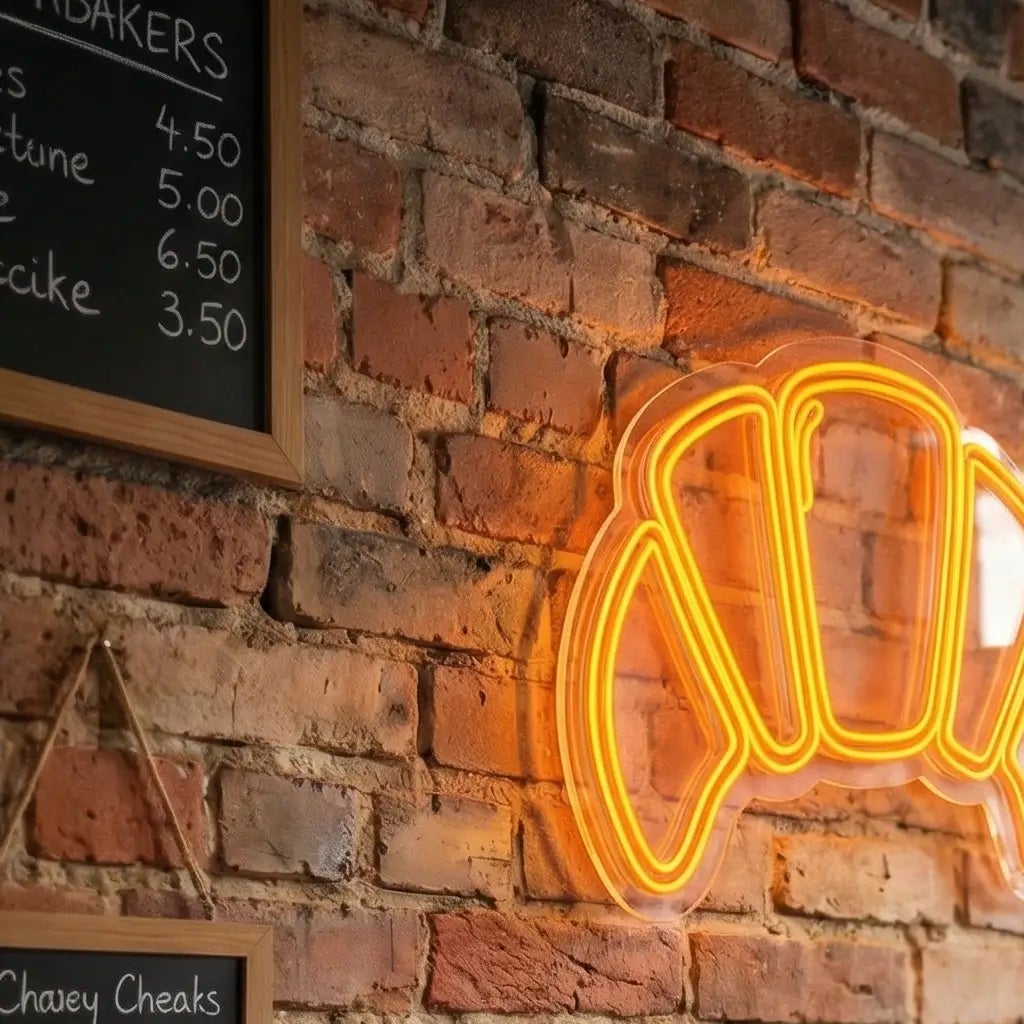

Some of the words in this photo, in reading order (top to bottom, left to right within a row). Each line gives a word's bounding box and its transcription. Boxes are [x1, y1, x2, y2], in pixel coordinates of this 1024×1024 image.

[36, 0, 228, 79] BAKERS
[155, 104, 241, 167] 4.50
[0, 112, 95, 184] tune
[157, 167, 243, 227] 5.00
[157, 228, 241, 284] 6.50
[157, 290, 247, 351] 3.50
[115, 973, 220, 1016] Cheaks
